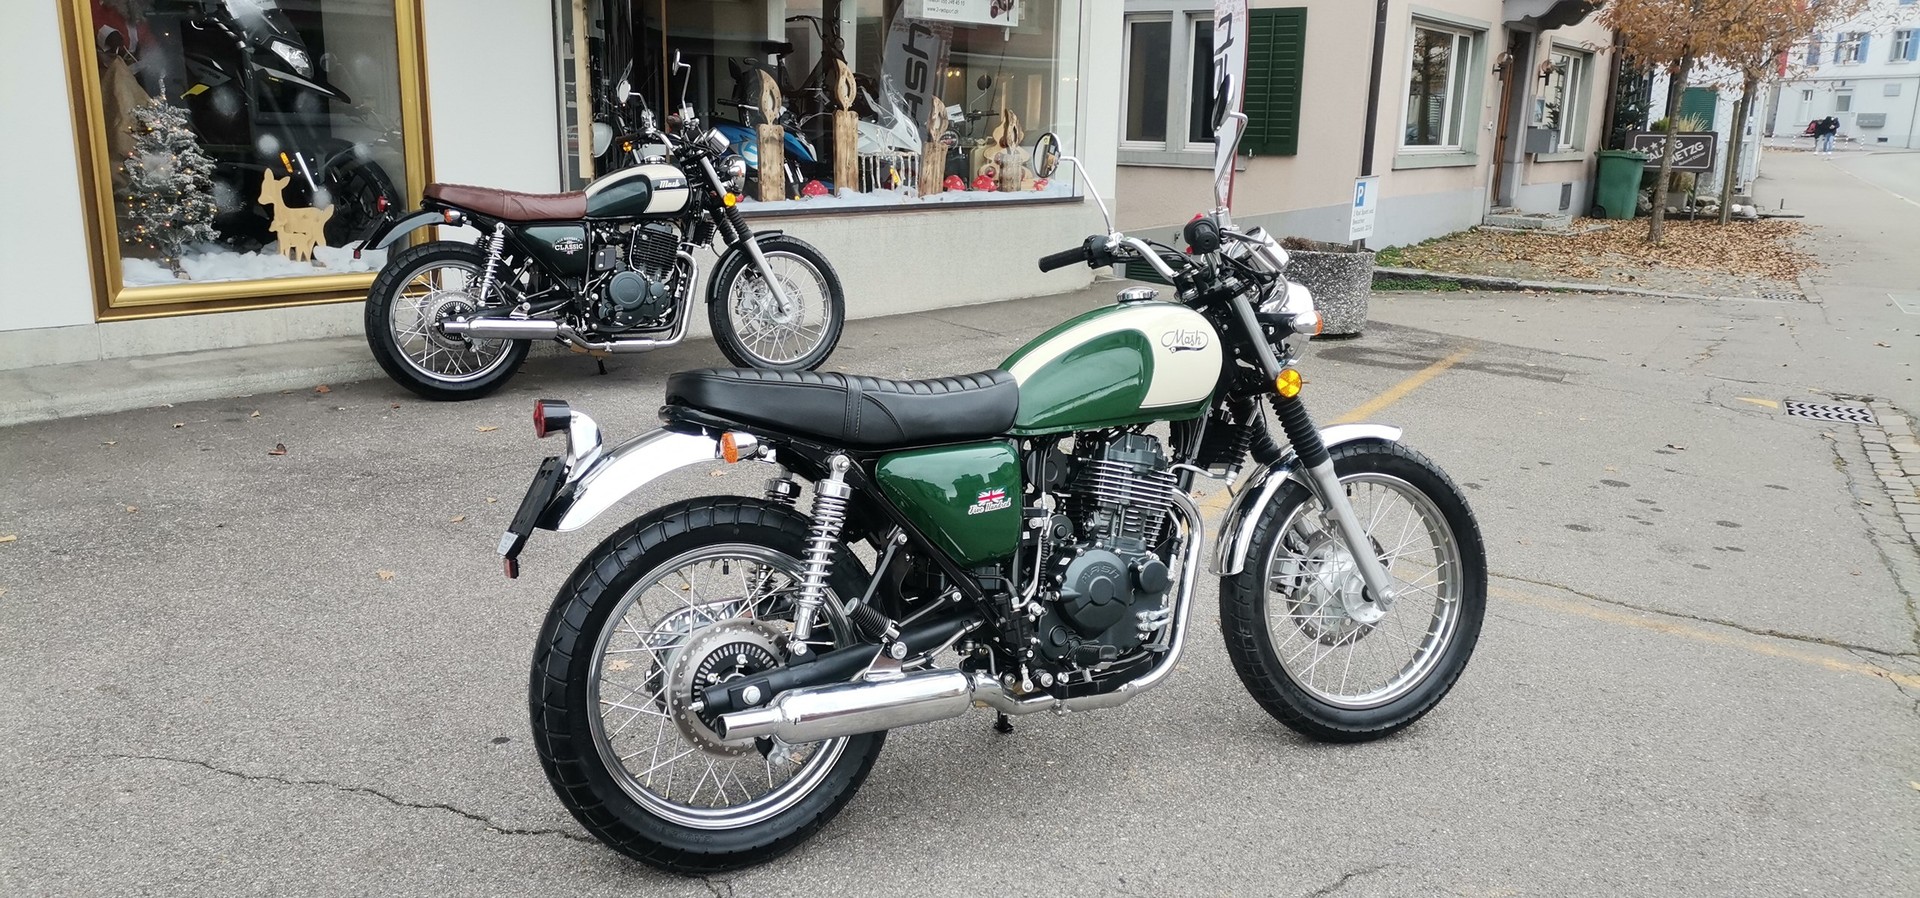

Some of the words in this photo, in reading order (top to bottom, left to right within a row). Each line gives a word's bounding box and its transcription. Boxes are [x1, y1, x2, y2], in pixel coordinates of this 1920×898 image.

[1357, 185, 1364, 204] P
[1161, 329, 1202, 348] Mash
[985, 497, 1012, 512] Hundred
